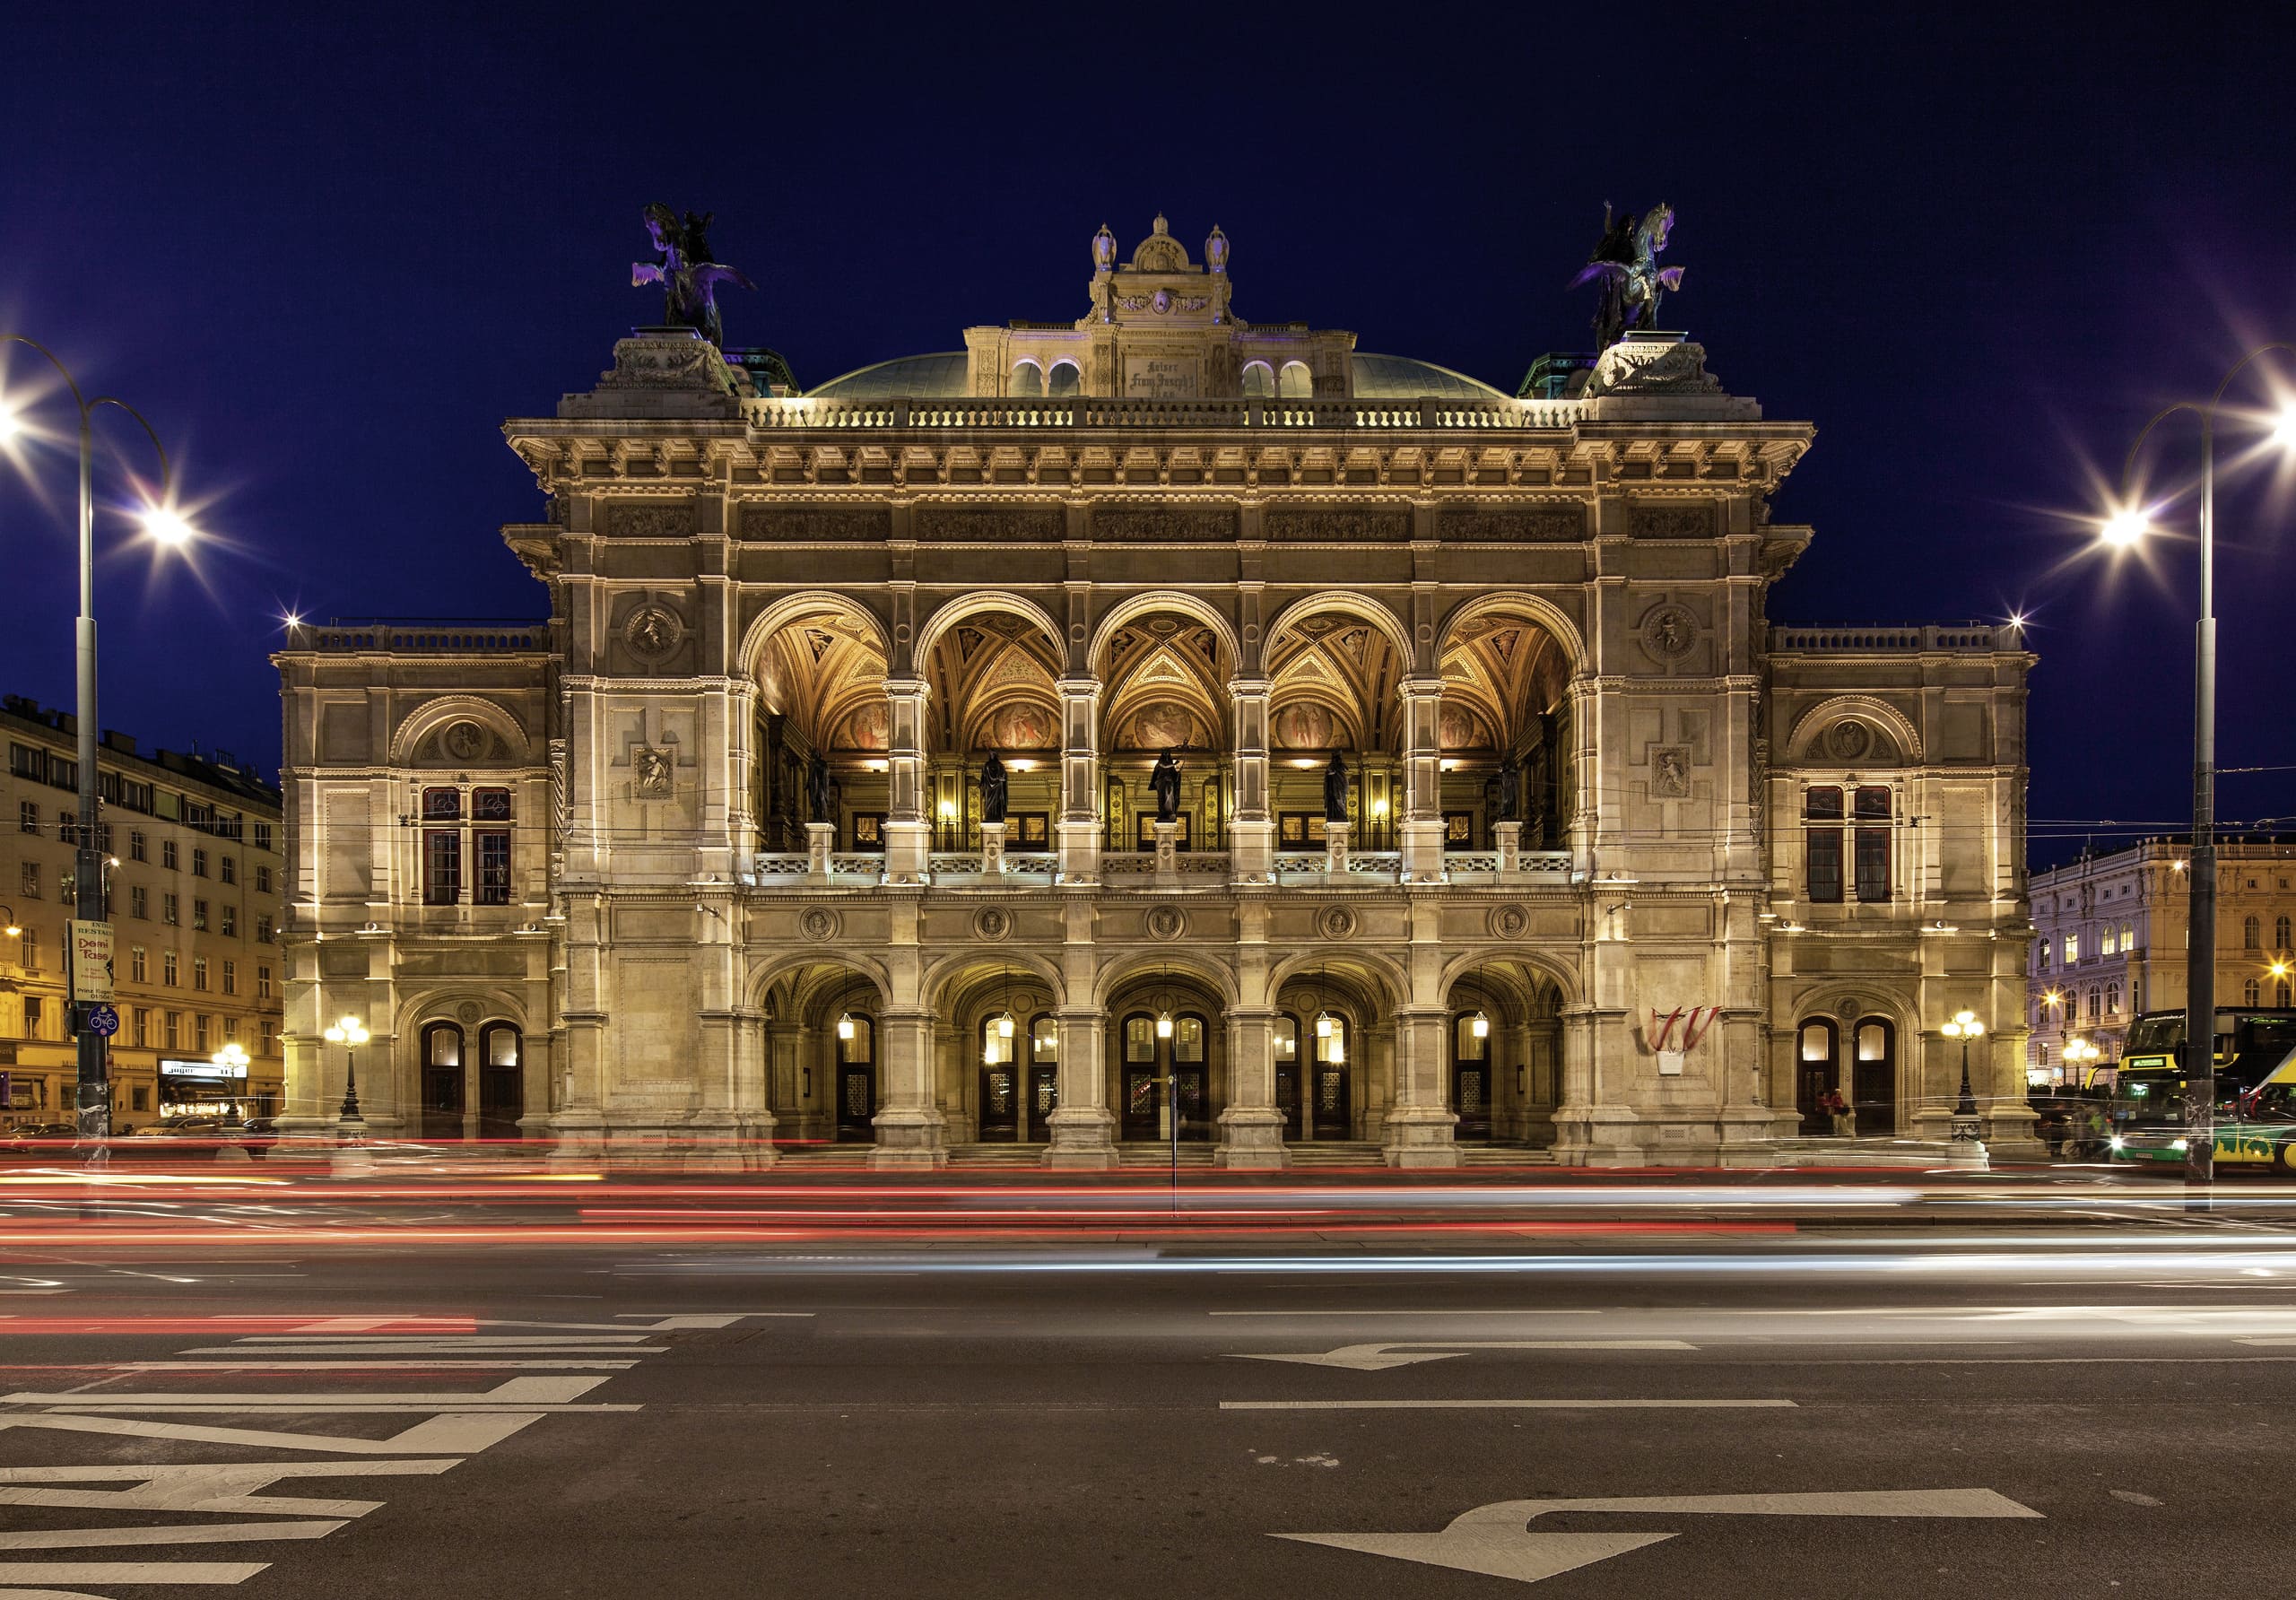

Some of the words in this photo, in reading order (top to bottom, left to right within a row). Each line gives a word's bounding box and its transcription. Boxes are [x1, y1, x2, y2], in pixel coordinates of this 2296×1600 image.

[1147, 361, 1178, 373] Kaiser
[1129, 373, 1155, 390] Franz
[79, 938, 109, 948] Demi
[79, 949, 109, 960] Tass
